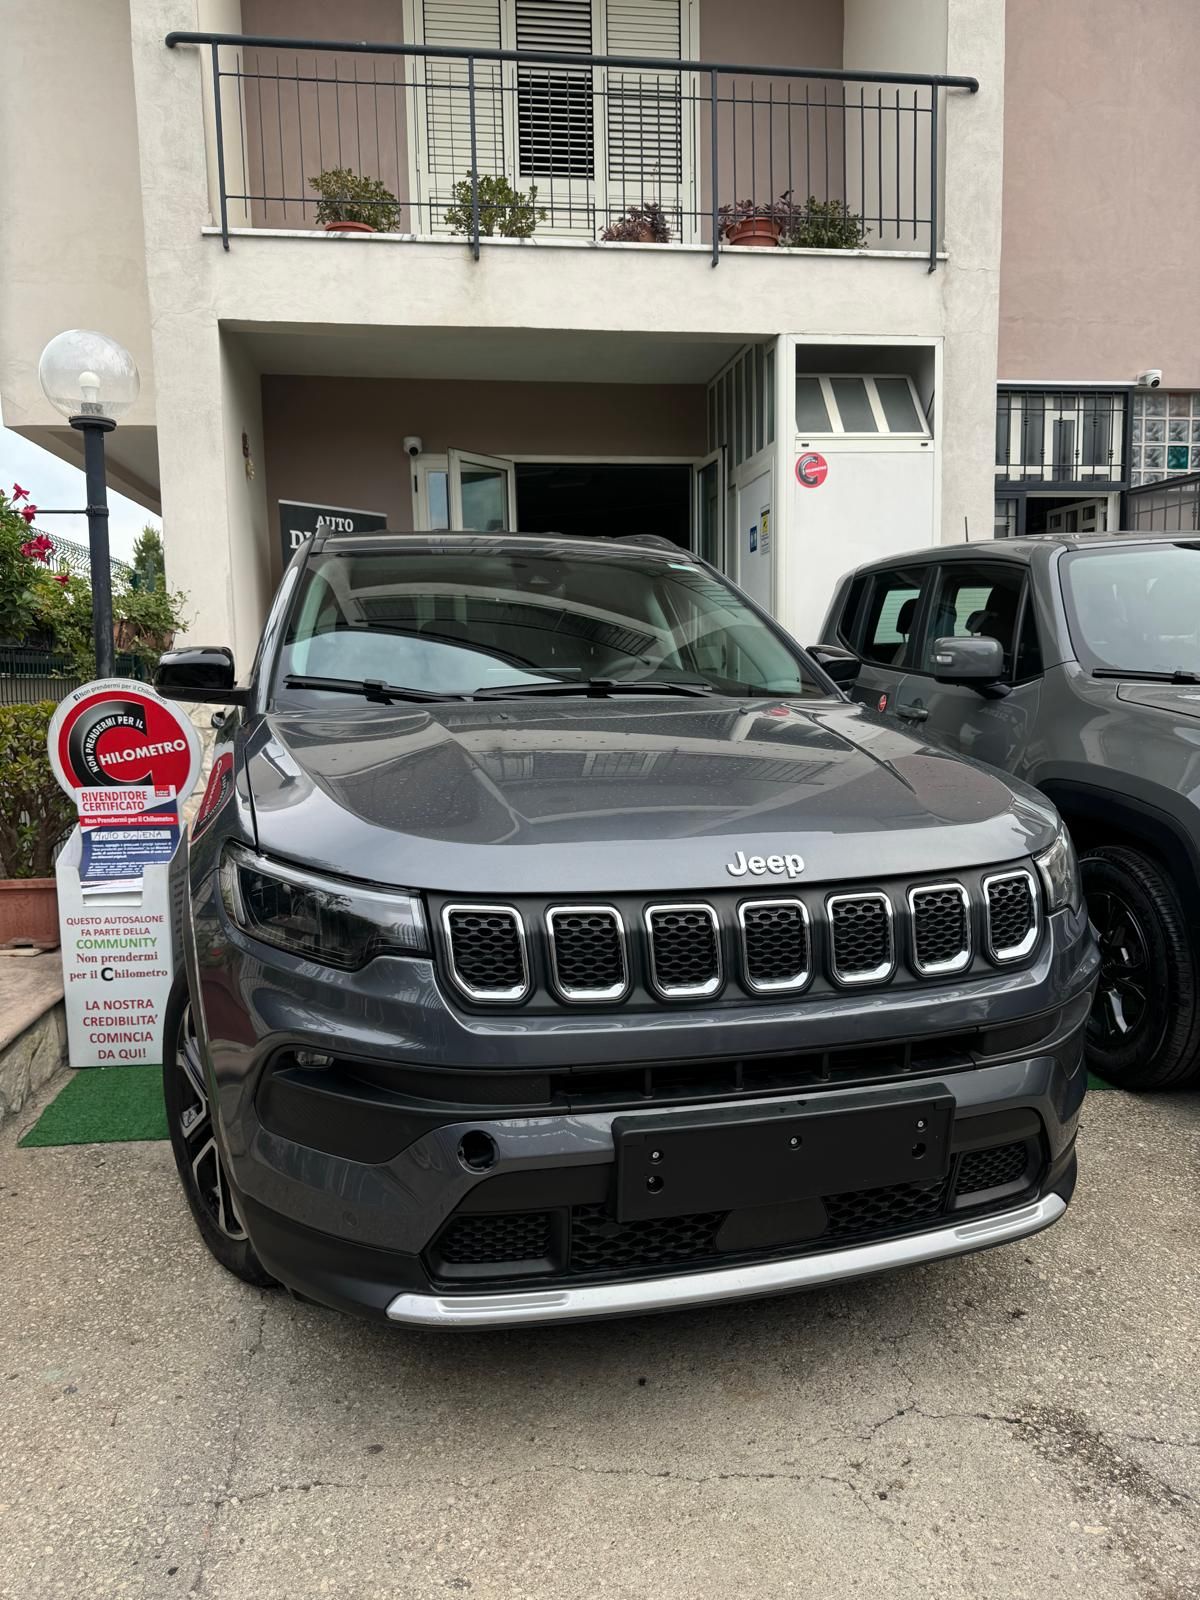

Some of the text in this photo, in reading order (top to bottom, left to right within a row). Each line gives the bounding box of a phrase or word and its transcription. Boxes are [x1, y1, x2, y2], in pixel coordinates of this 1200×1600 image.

[316, 515, 354, 532] AUTO
[79, 689, 90, 697] Non
[91, 683, 120, 693] prendermi
[137, 686, 168, 705] Chilometro
[86, 716, 144, 773] NON PRENDERMI PER IL
[81, 791, 148, 802] RIVENDITORE
[83, 801, 145, 812] CERTIFICATO
[143, 815, 175, 823] Chilometro
[726, 851, 805, 878] Jeep
[66, 915, 164, 926] QUESTO AUTOSALONE
[81, 927, 150, 937] FA PARTE DELLA
[76, 937, 157, 950] COMMUNITY
[76, 951, 158, 965] Non prendermi
[69, 967, 168, 982] per il Chilometro
[85, 999, 154, 1011] LA NOSTRA
[83, 1014, 158, 1027] CREDIBILITA'
[89, 1031, 154, 1044] COMINCIA
[98, 1048, 147, 1060] DA QUI!
